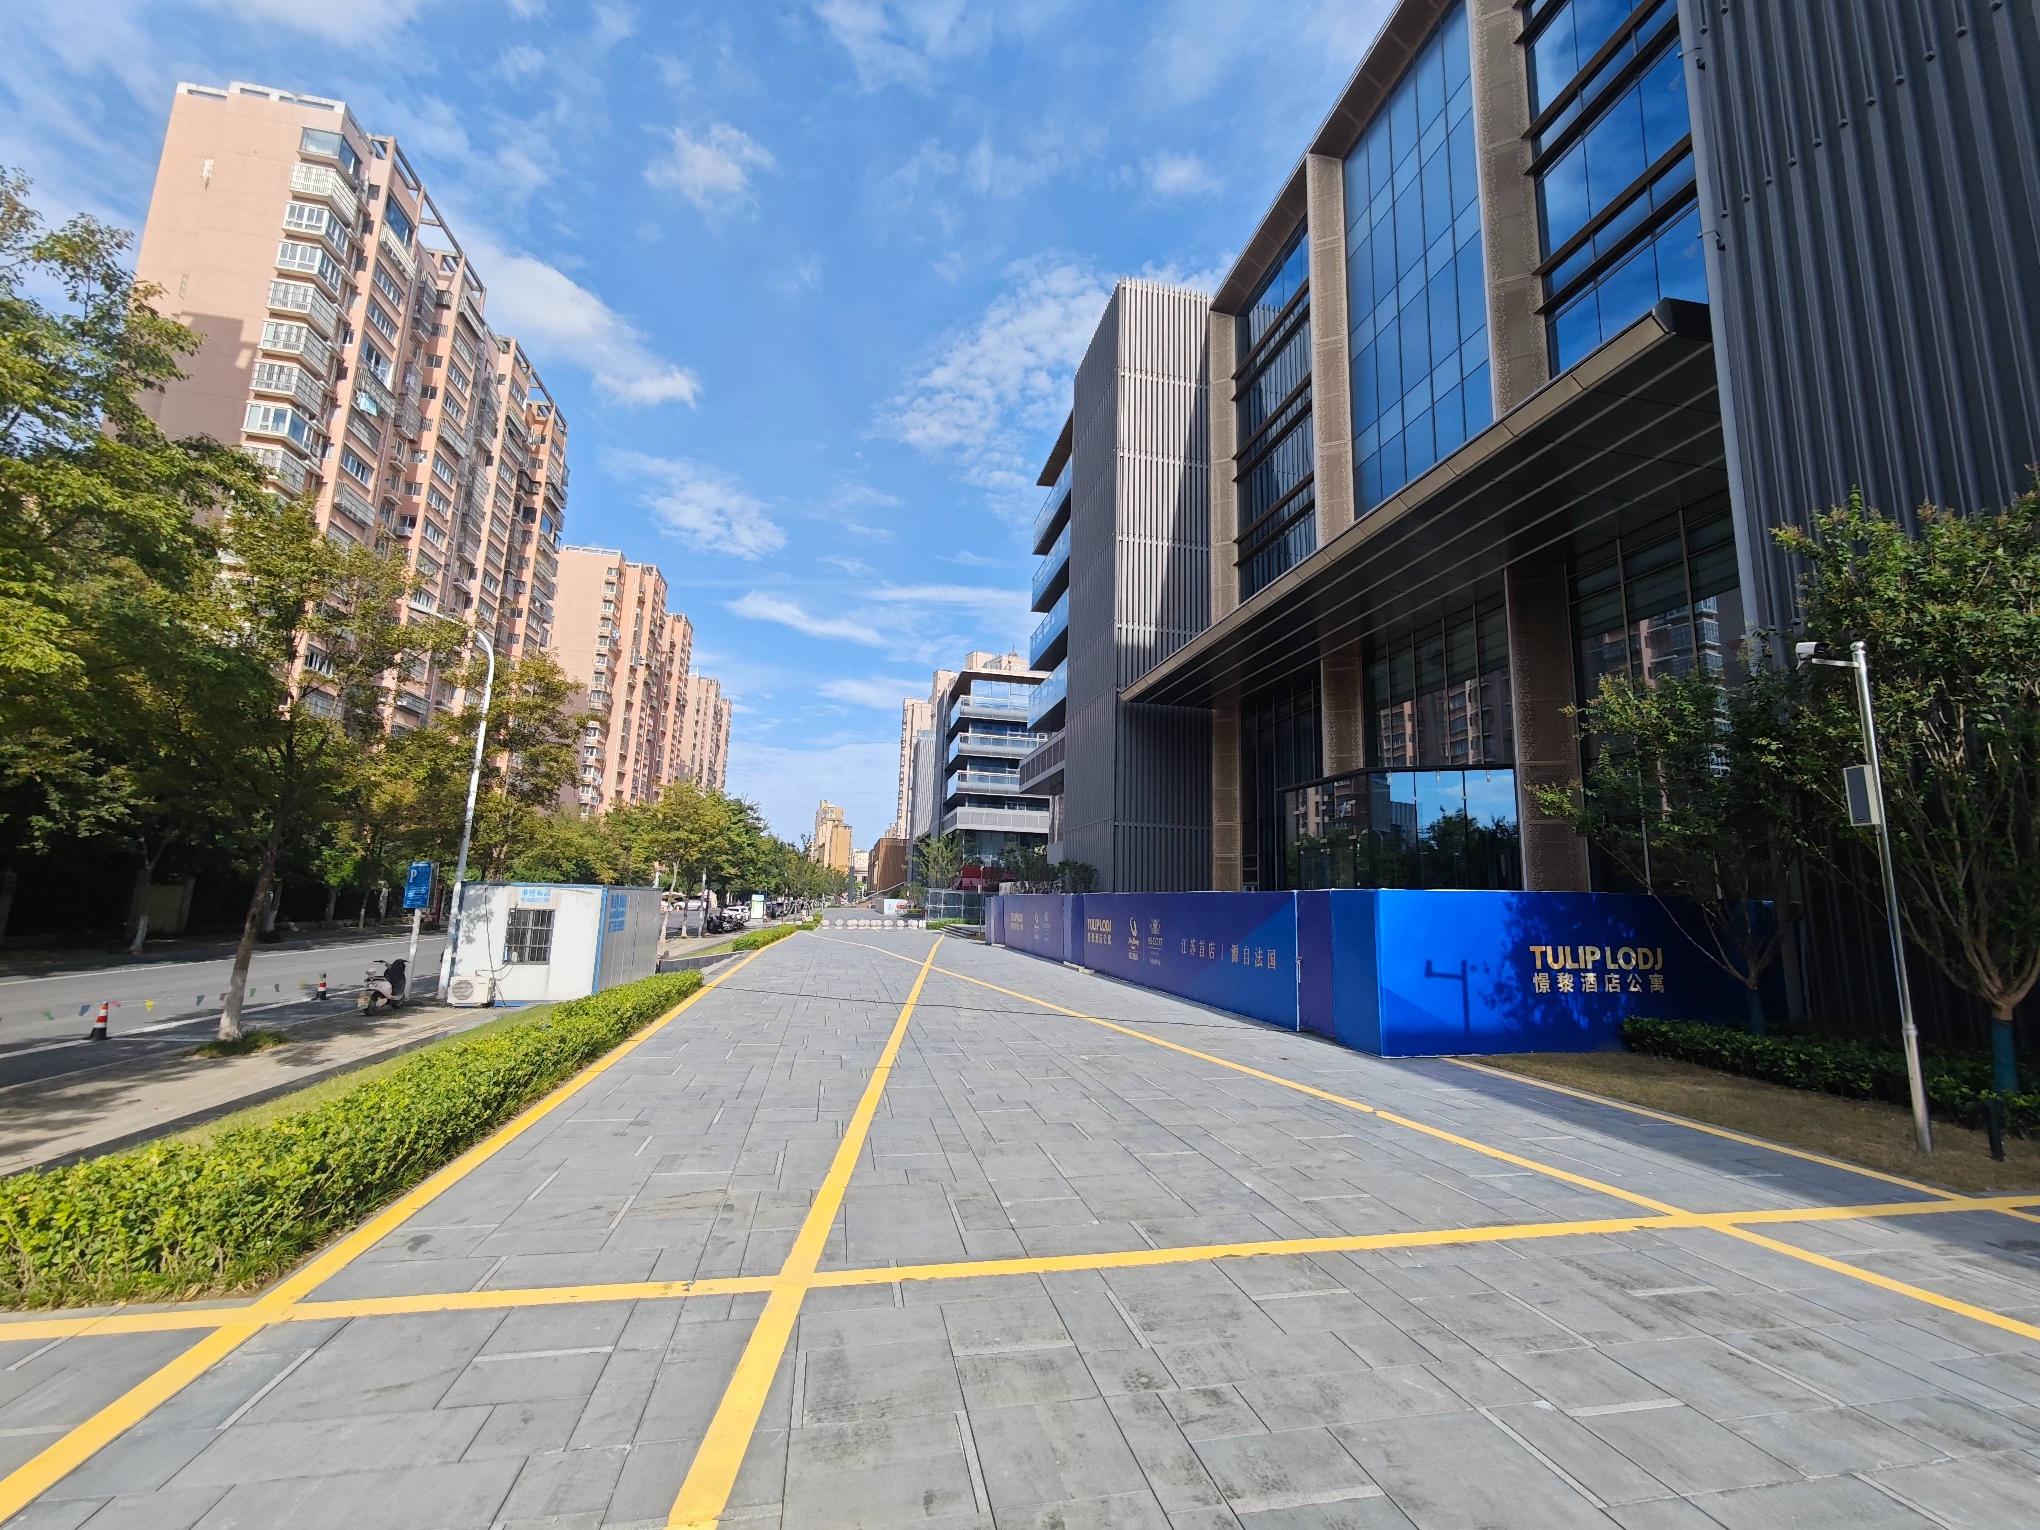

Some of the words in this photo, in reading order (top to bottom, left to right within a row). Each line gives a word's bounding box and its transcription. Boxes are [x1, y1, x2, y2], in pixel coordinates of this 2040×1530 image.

[409, 869, 418, 883] P
[1180, 938, 1216, 960] 江苏首店
[1529, 945, 1601, 970] TULIP
[1605, 946, 1664, 971] LODJ
[1532, 972, 1665, 993] 憬黎酒店公寓
